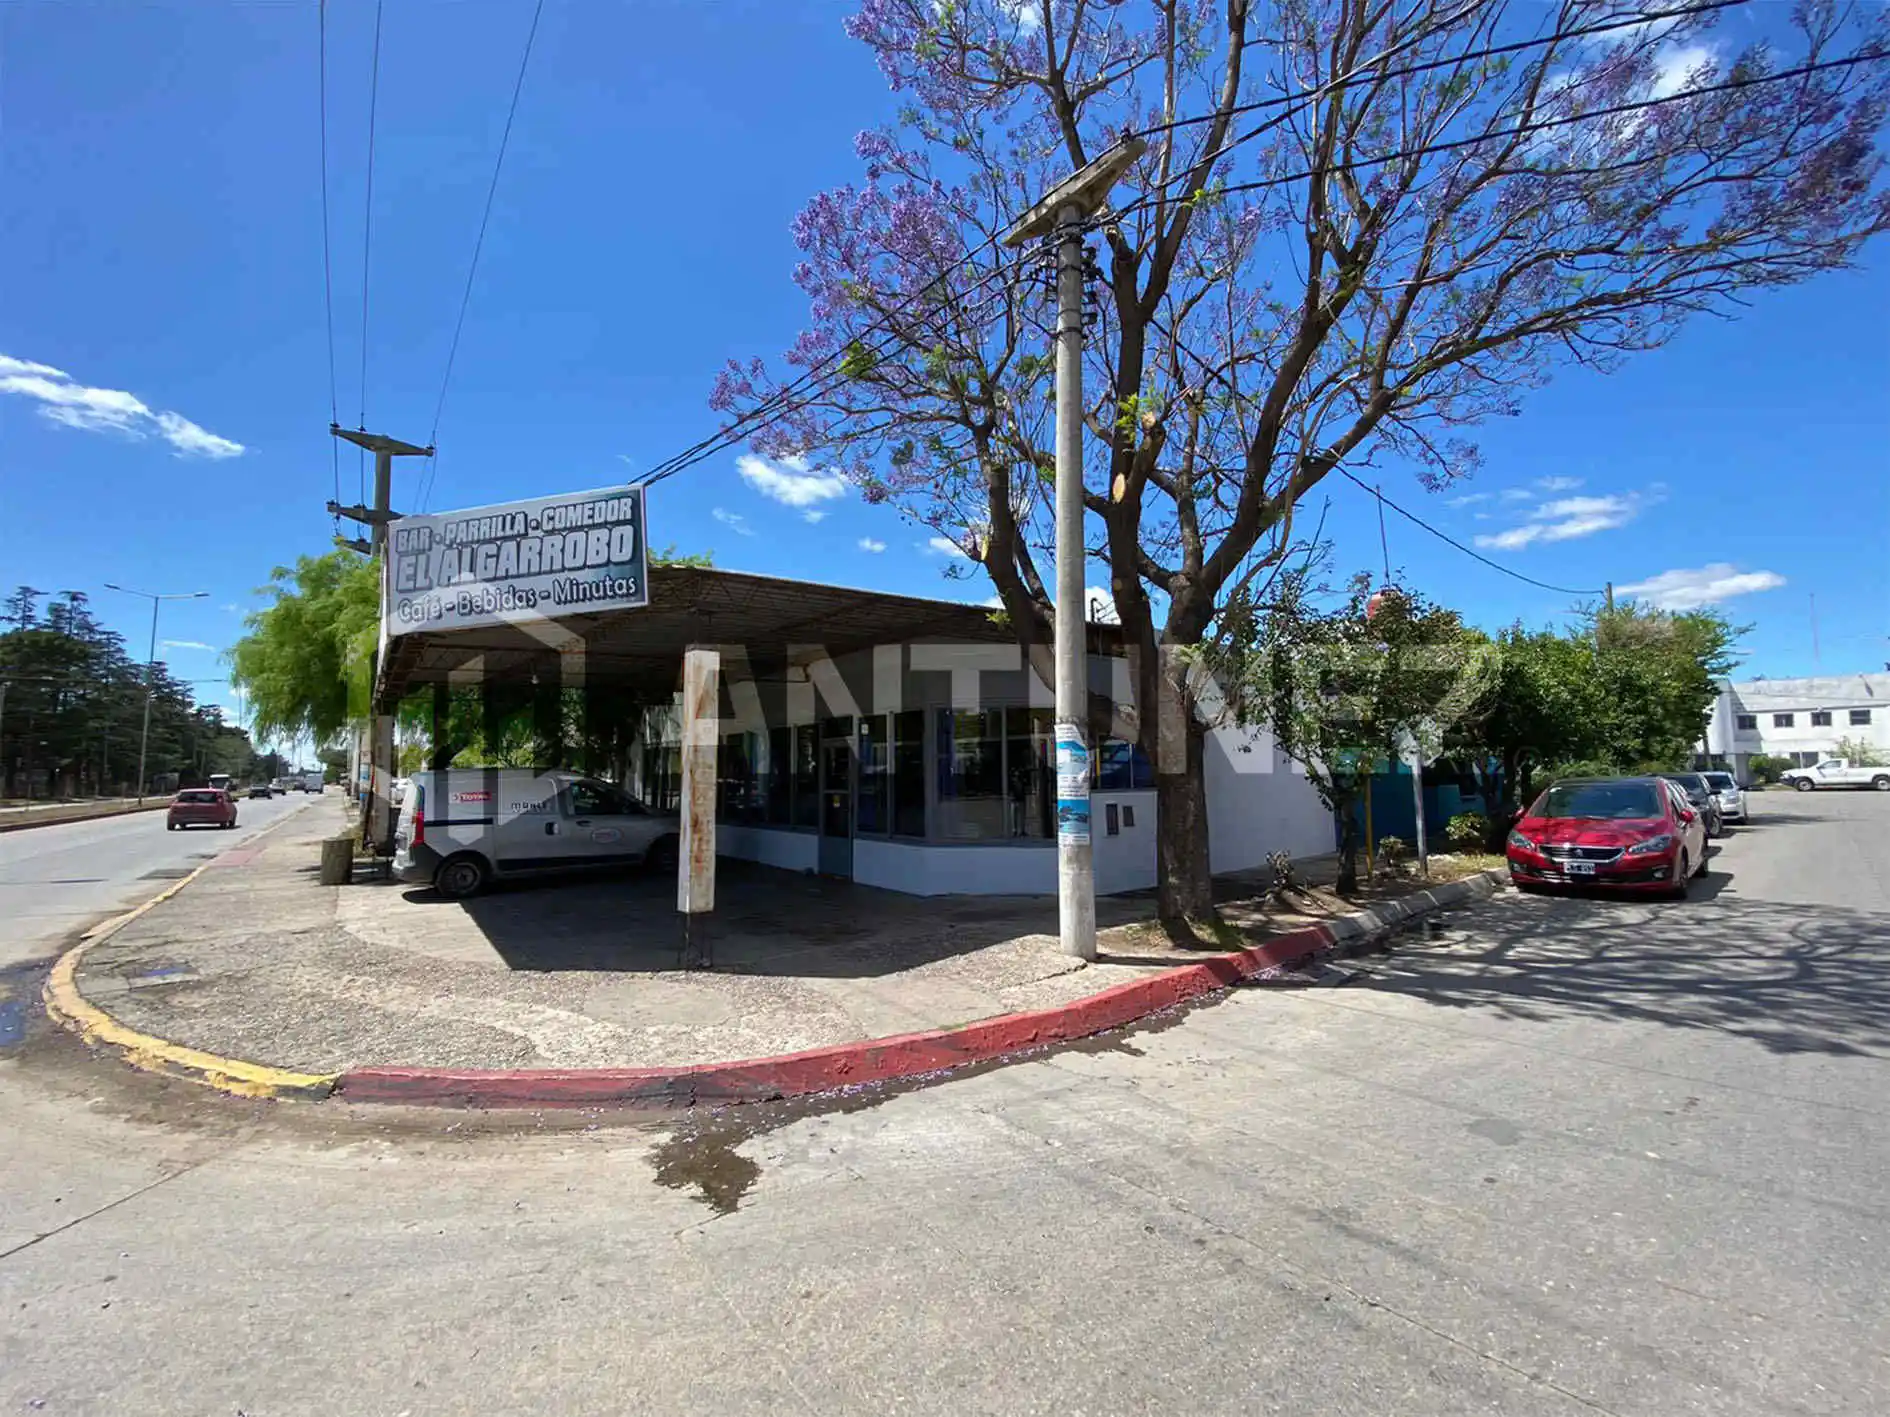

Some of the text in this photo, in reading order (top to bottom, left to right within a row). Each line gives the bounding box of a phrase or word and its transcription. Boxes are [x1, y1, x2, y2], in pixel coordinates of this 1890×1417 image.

[396, 496, 633, 552] BAR PARRILLA COMEDOR
[396, 524, 634, 592] EL ALGARROBO
[457, 583, 537, 616] Bebidas
[553, 575, 636, 605] Minutas
